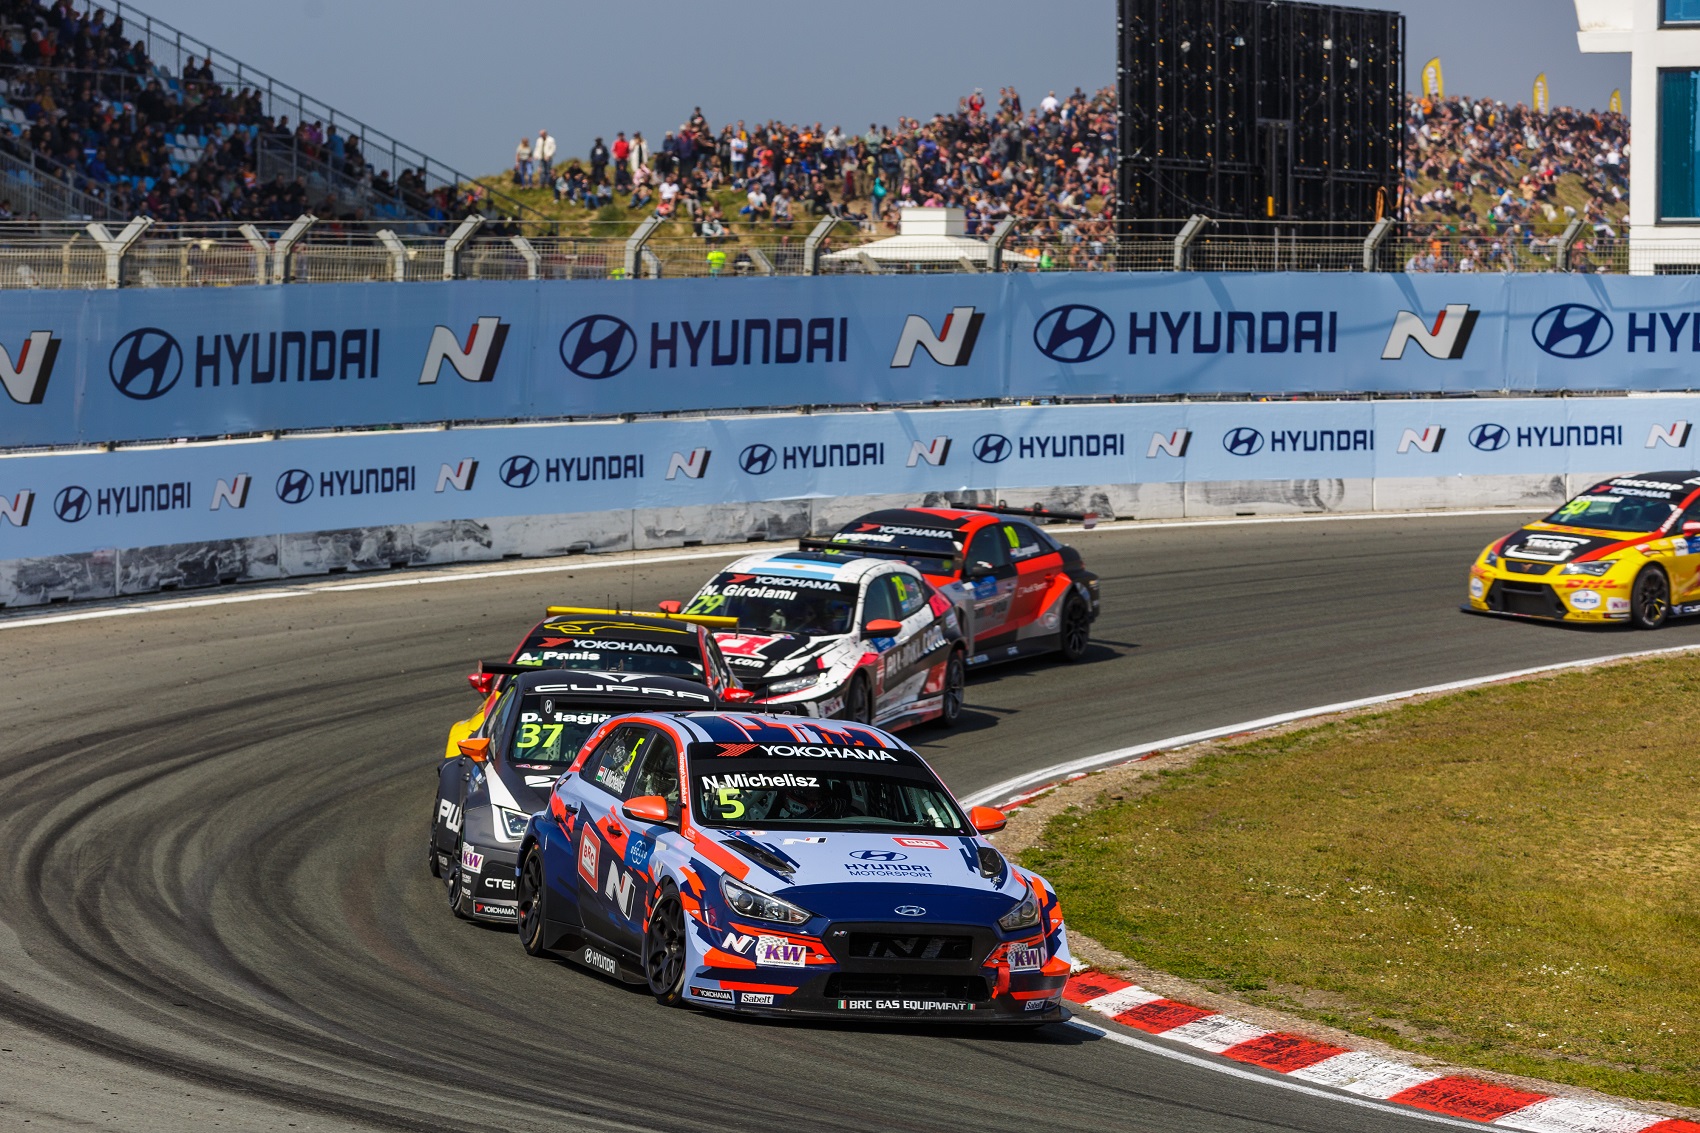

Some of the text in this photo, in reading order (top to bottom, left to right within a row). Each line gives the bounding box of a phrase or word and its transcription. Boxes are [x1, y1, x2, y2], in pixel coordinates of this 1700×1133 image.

[1128, 310, 1338, 355] HYUNDAI
[650, 317, 848, 370] HYUNDAI
[195, 328, 380, 388] HYUNDAI
[1271, 429, 1374, 452] HYUNDAI
[1517, 425, 1622, 448] HYUNDAI
[1020, 433, 1124, 459] HYUNDAI
[783, 442, 884, 470] HYUNDAI
[546, 454, 644, 483] HYUNDAI
[320, 466, 415, 498] HYUNDAI
[1609, 478, 1684, 491] TRICORP
[97, 481, 192, 516] HYUNDAI
[878, 525, 953, 539] YOKOHAMA
[701, 584, 797, 601] N. Girolami
[754, 576, 841, 592] YOKOHAMA
[1565, 579, 1617, 589] DHL
[686, 595, 725, 615] 29
[573, 639, 678, 655] YOKOHAMA
[516, 651, 600, 662] A. Panis
[534, 684, 710, 702] CUPRA
[522, 712, 543, 723] D.
[516, 723, 564, 748] 37
[760, 744, 898, 762] YOKOHAMA
[718, 788, 745, 819] 5
[462, 851, 482, 868] KW
[584, 844, 595, 867] BRC
[844, 863, 931, 872] HYUNDAI
[849, 870, 933, 878] MOTORSPORT
[483, 905, 516, 916] YOKOHAMA
[764, 944, 804, 963] KW
[1014, 950, 1038, 967] KW
[699, 989, 732, 1000] YOKOHAMA
[743, 993, 772, 1004] Sabelt
[849, 1000, 872, 1009] BRC
[875, 1000, 900, 1009] GAS
